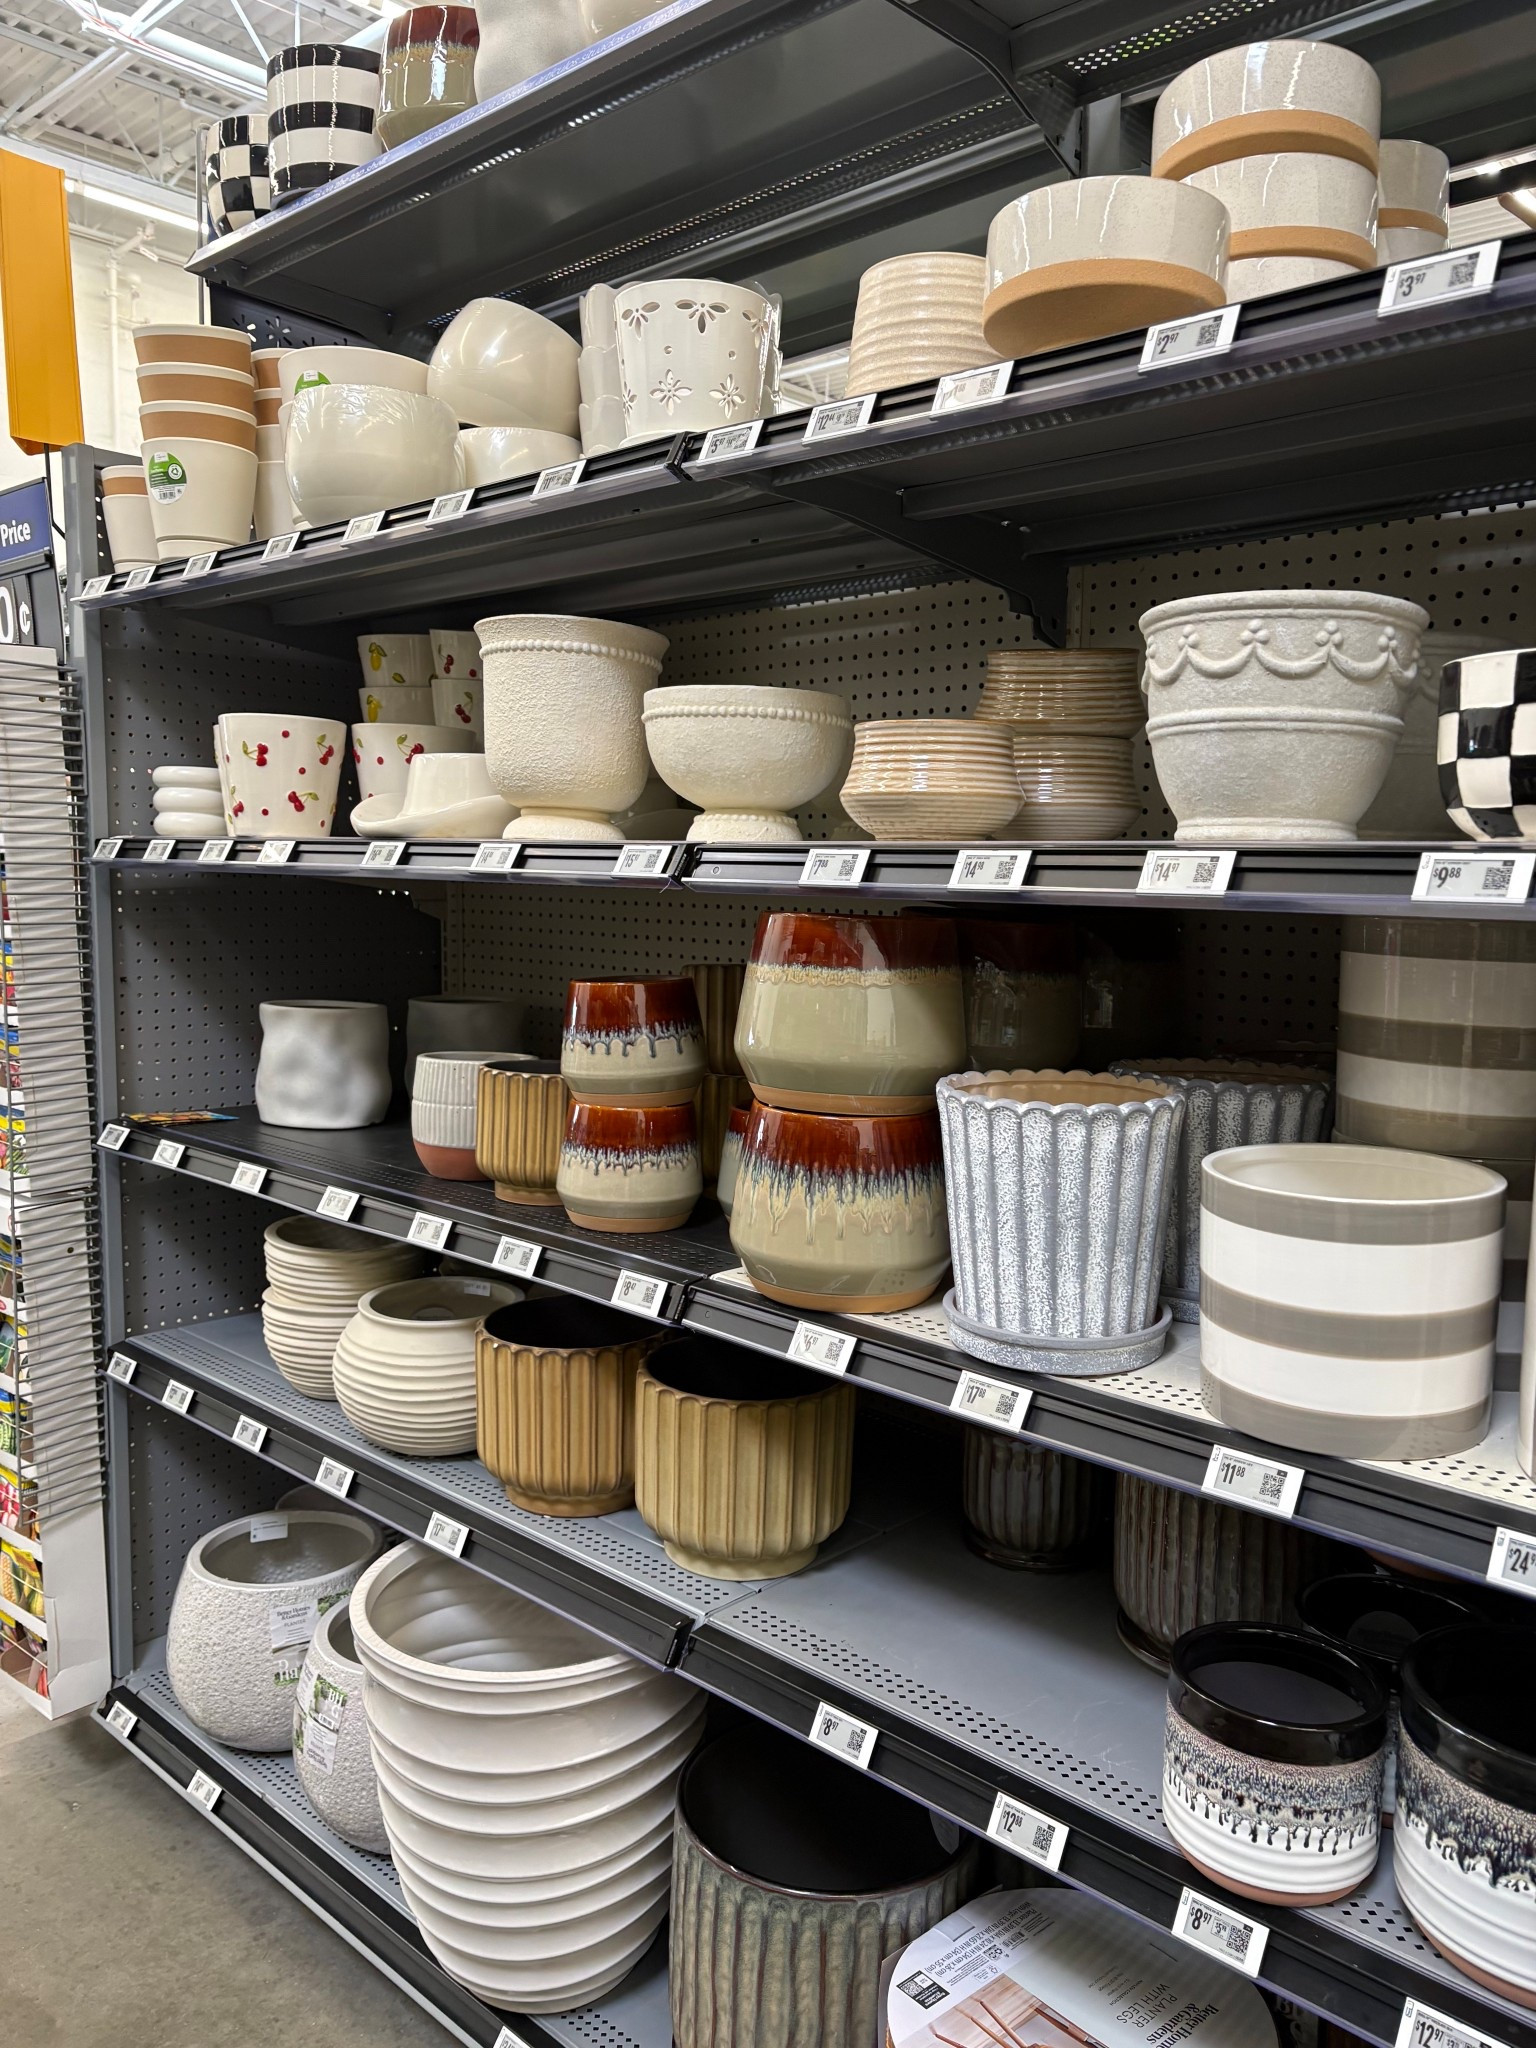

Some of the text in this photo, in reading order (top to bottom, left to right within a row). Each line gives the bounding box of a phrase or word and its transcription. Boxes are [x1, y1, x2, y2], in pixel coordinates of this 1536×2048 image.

[626, 25, 641, 40] en
[1, 519, 31, 548] Price
[1141, 1983, 1171, 2005] WITH
[1116, 2003, 1145, 2024] LEGS
[1131, 1993, 1178, 2028] PLANTER
[1156, 2003, 1220, 2048] Better Home
